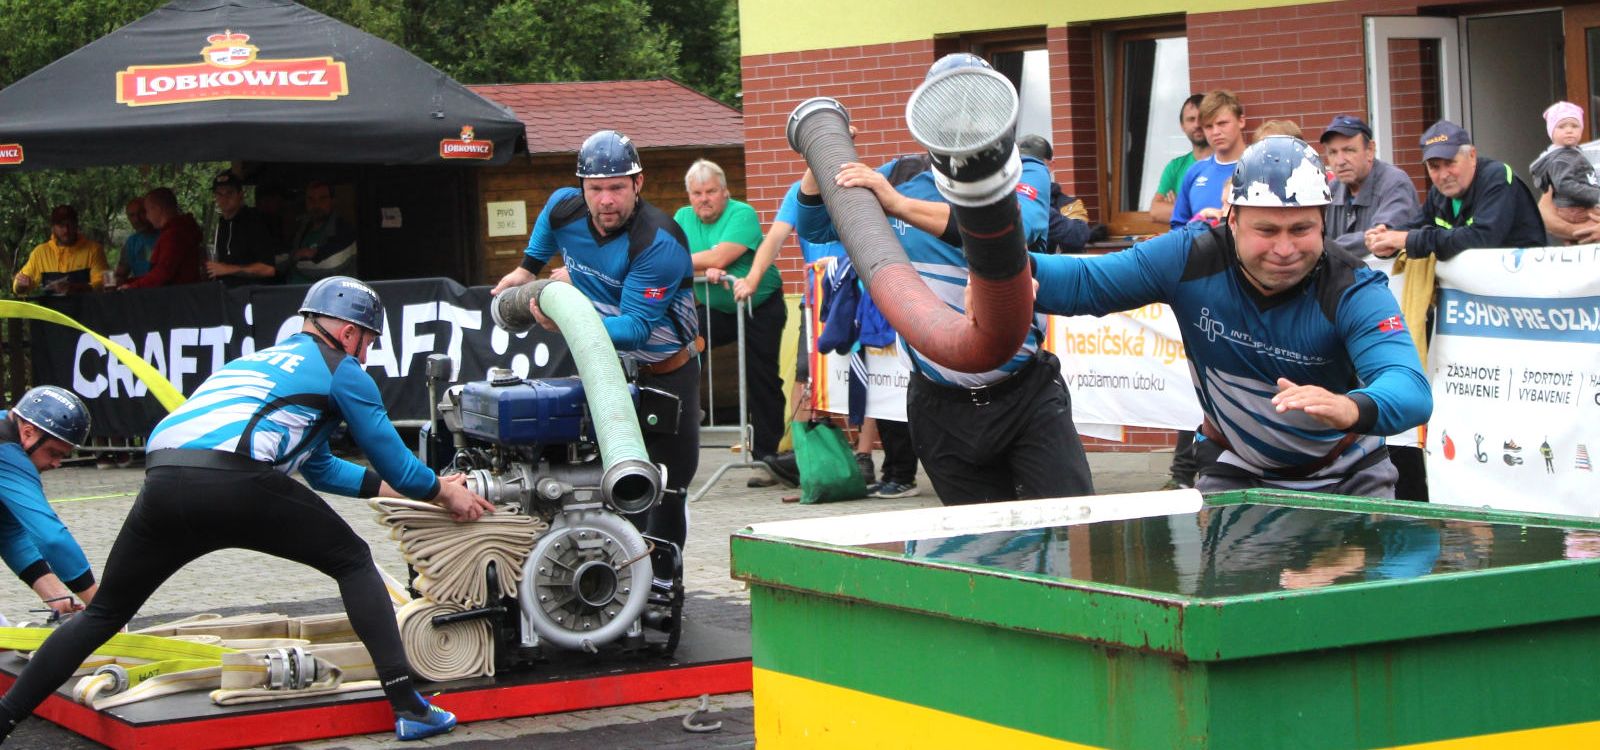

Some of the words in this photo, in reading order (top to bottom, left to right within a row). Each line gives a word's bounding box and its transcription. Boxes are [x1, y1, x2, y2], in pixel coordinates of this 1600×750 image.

[136, 69, 328, 97] LOBKOWICZ
[444, 143, 489, 154] LOBKOWICZ
[1446, 300, 1510, 327] E-SHOP
[1510, 307, 1550, 330] PRE
[1549, 307, 1600, 331] OZAJ
[1064, 325, 1145, 357] hasičská
[73, 325, 233, 399] CRAFT
[1447, 363, 1500, 381] ZÁSAHOVÉ
[1066, 374, 1075, 386] v
[1133, 370, 1166, 392] útoku
[1522, 368, 1573, 387] ŠPORTOVÉ
[1446, 382, 1500, 399] VYBAVENIE
[1519, 388, 1571, 405] VYBAVENIE
